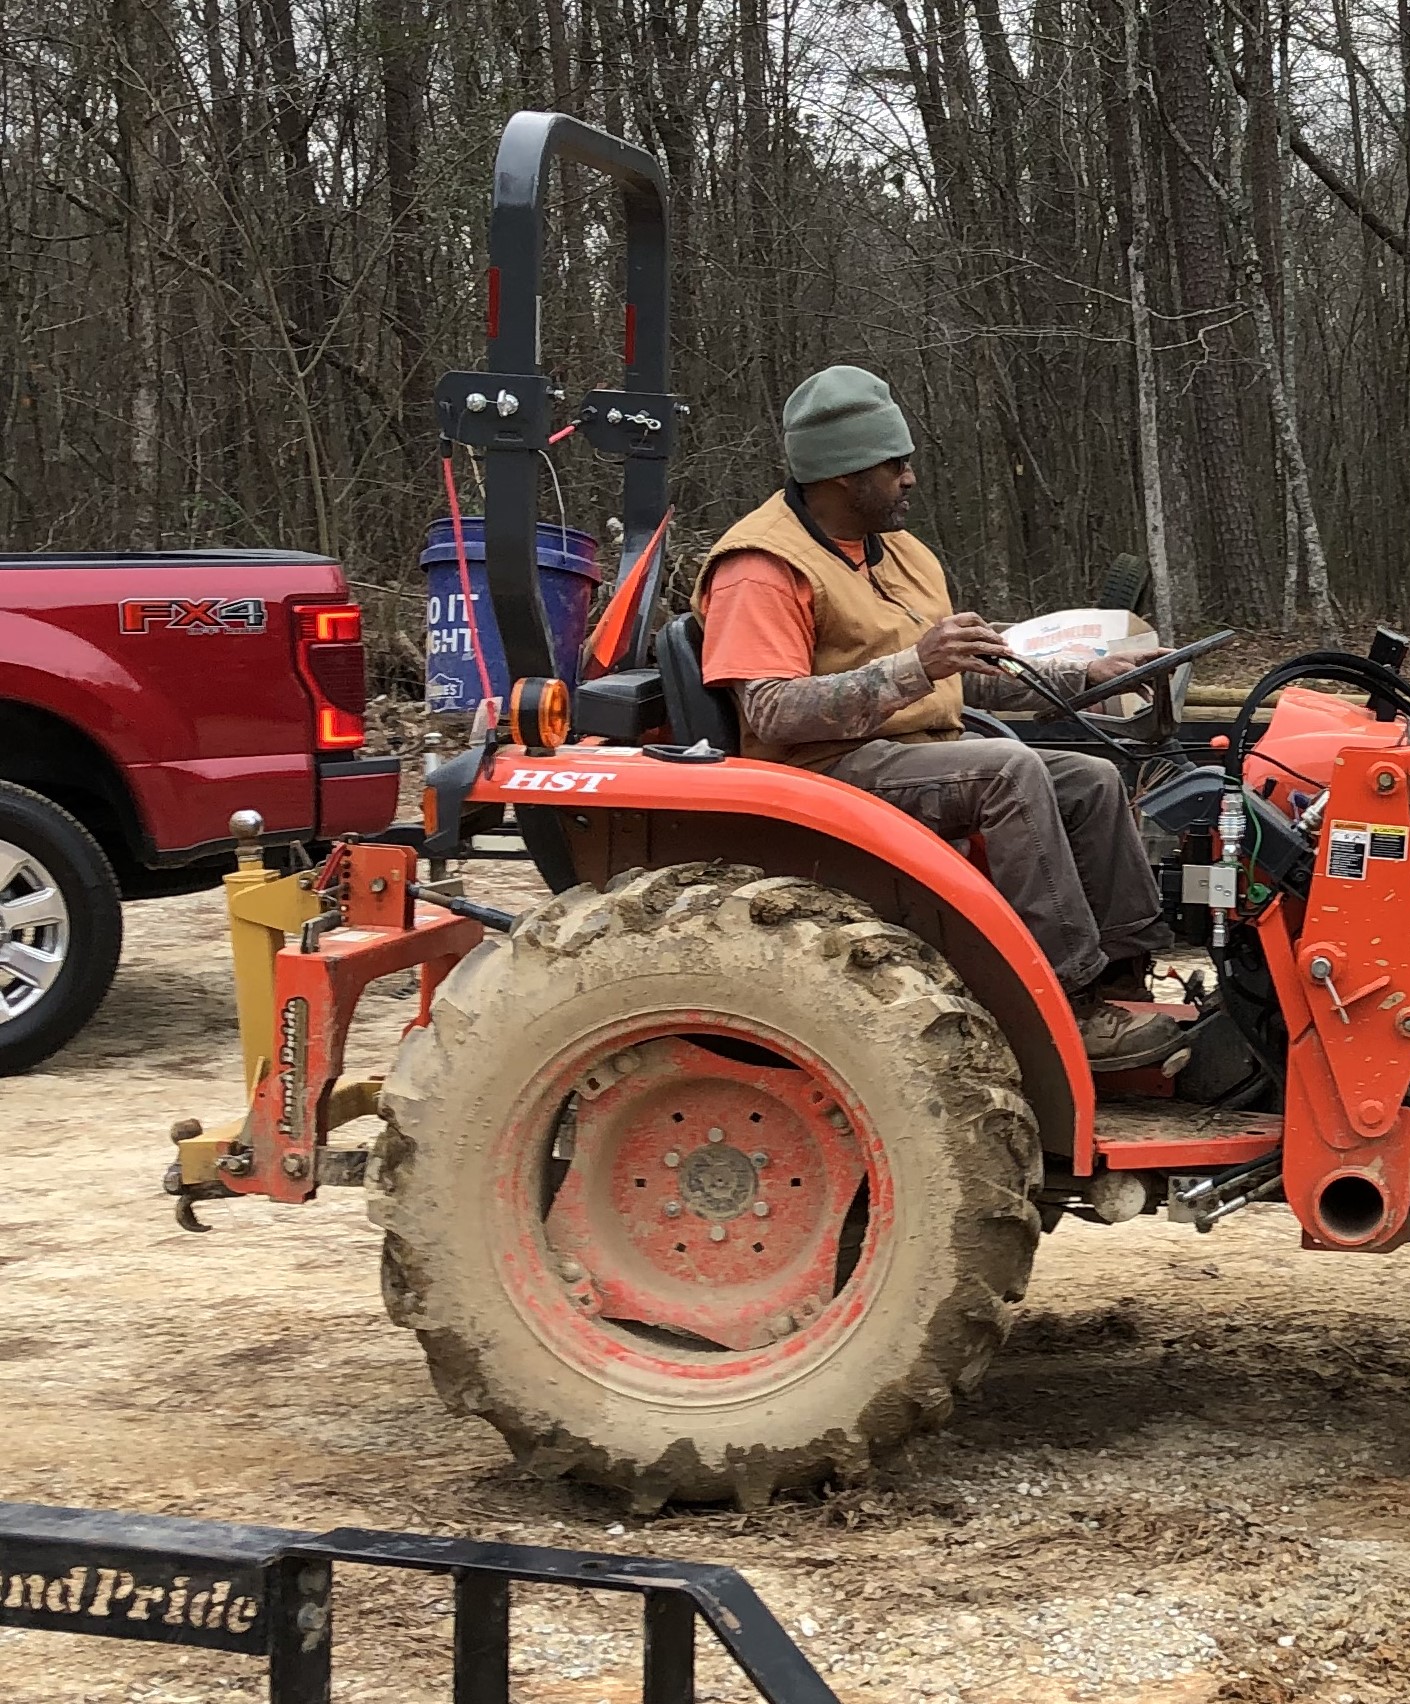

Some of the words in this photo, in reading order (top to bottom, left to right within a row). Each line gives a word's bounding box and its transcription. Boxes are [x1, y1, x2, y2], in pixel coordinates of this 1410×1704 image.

[118, 598, 268, 635] FX4
[428, 596, 441, 625] O
[447, 594, 479, 622] IT
[428, 628, 479, 655] GHT
[500, 769, 617, 793] HST
[0, 1565, 258, 1634] ndPride
